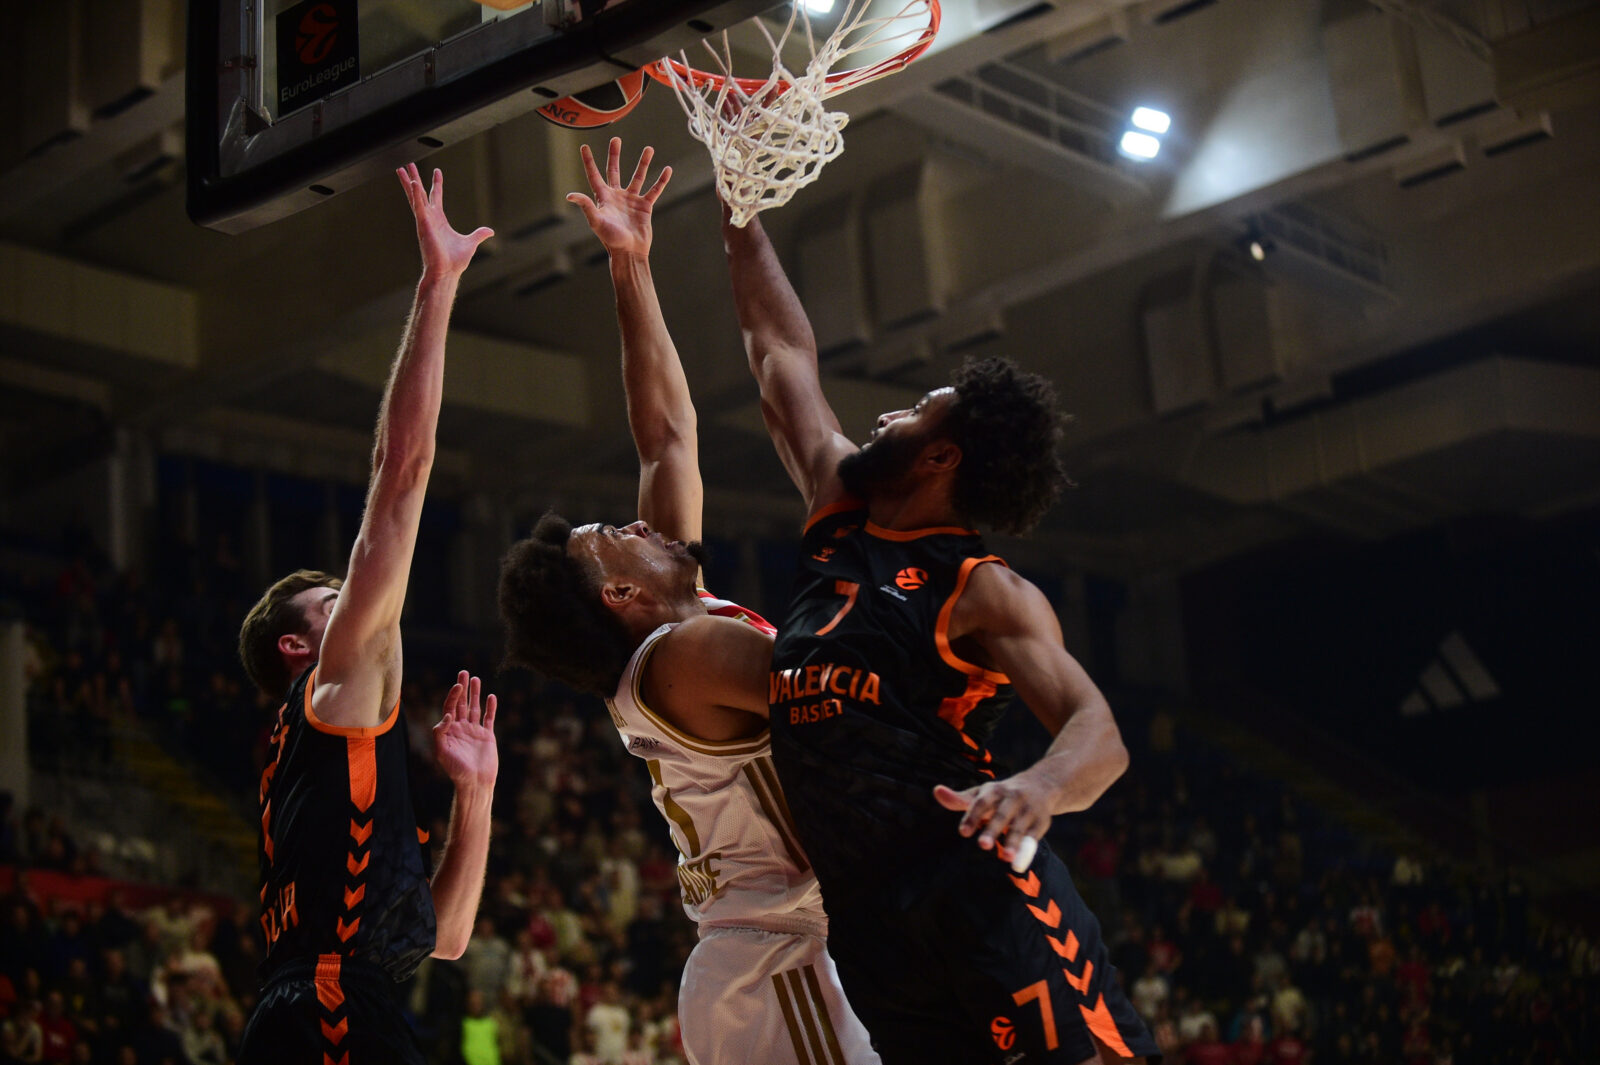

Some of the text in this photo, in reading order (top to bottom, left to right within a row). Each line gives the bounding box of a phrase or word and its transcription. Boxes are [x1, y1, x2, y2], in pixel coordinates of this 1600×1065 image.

[281, 56, 356, 103] EuroLeague
[815, 580, 861, 637] 7
[1010, 979, 1061, 1051] 7
